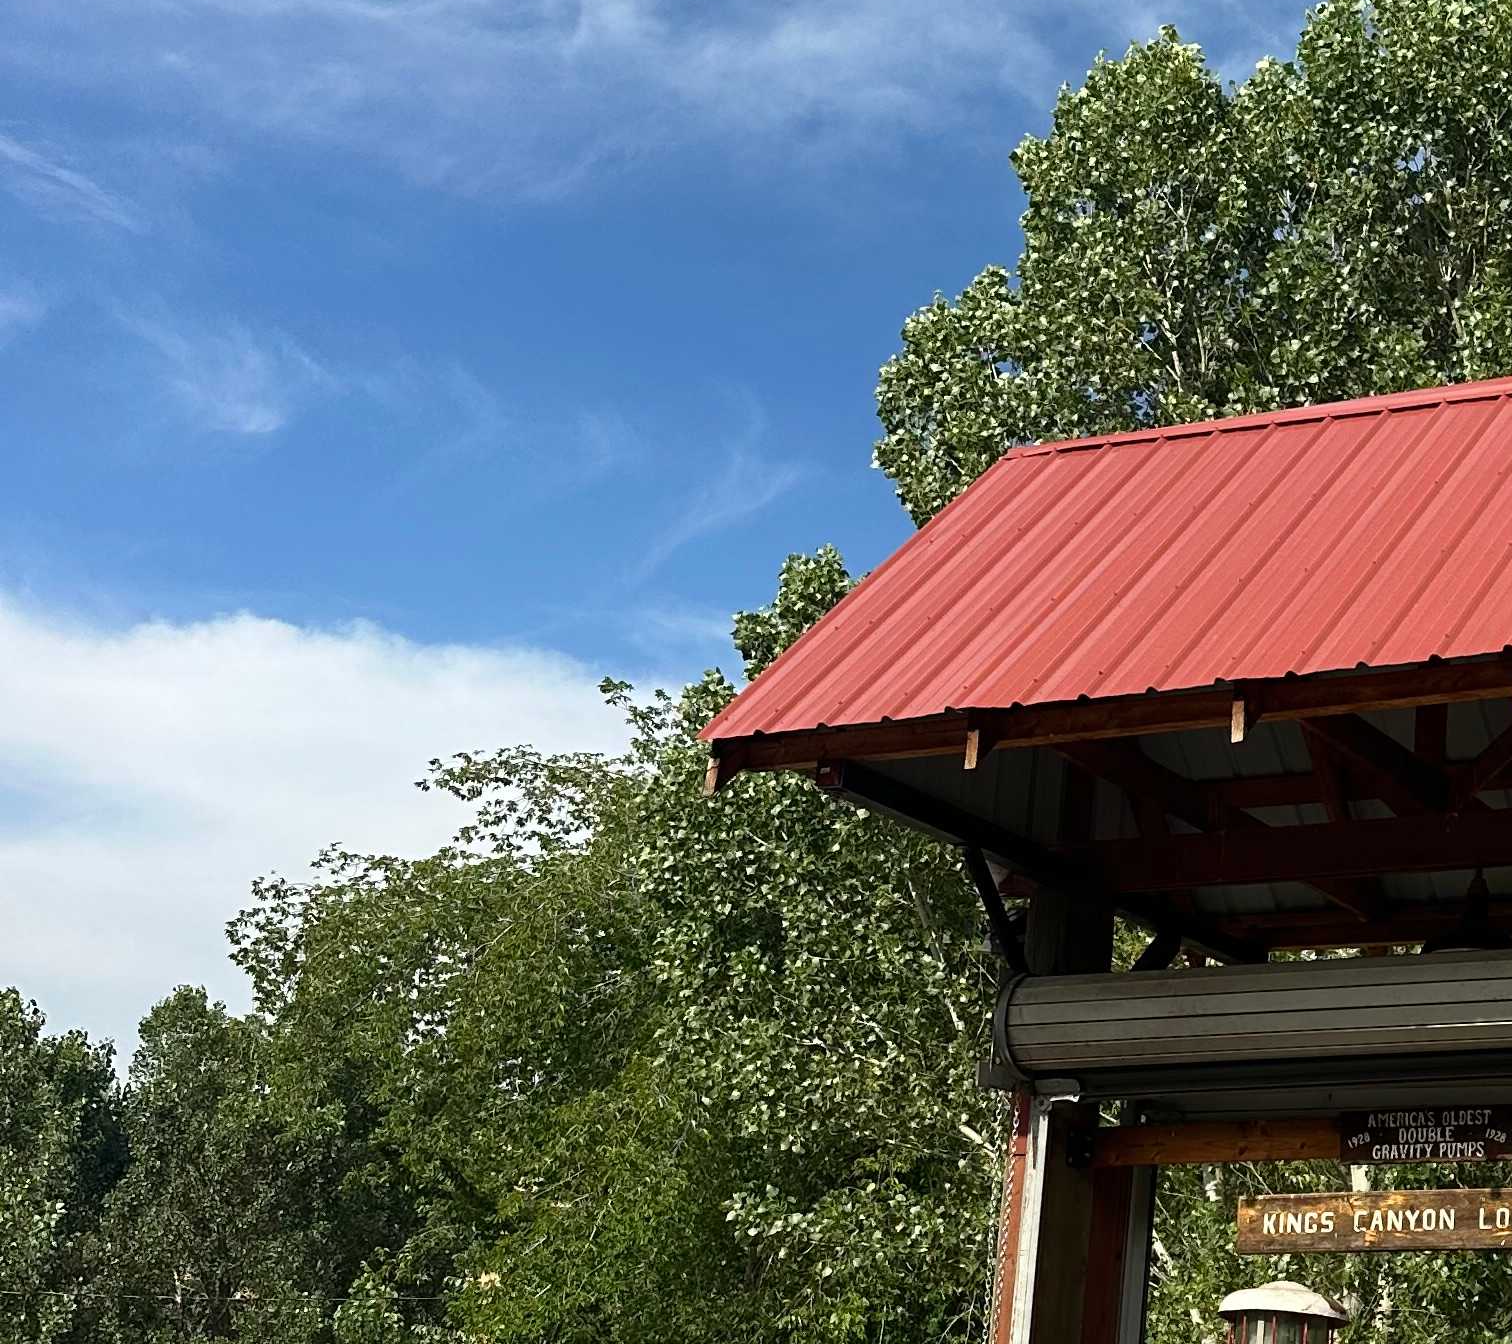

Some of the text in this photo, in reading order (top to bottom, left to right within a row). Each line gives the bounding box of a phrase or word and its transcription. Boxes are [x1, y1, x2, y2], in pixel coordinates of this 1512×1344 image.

[1367, 1109, 1492, 1128] AMERICA'S OLDEST
[1347, 1132, 1371, 1149] 1928
[1398, 1126, 1455, 1144] DOUBLE
[1485, 1128, 1507, 1143] 1928
[1372, 1141, 1485, 1160] GRAVITY PUMPS
[1262, 1211, 1335, 1235] KINGS
[1353, 1207, 1456, 1233] CANYON
